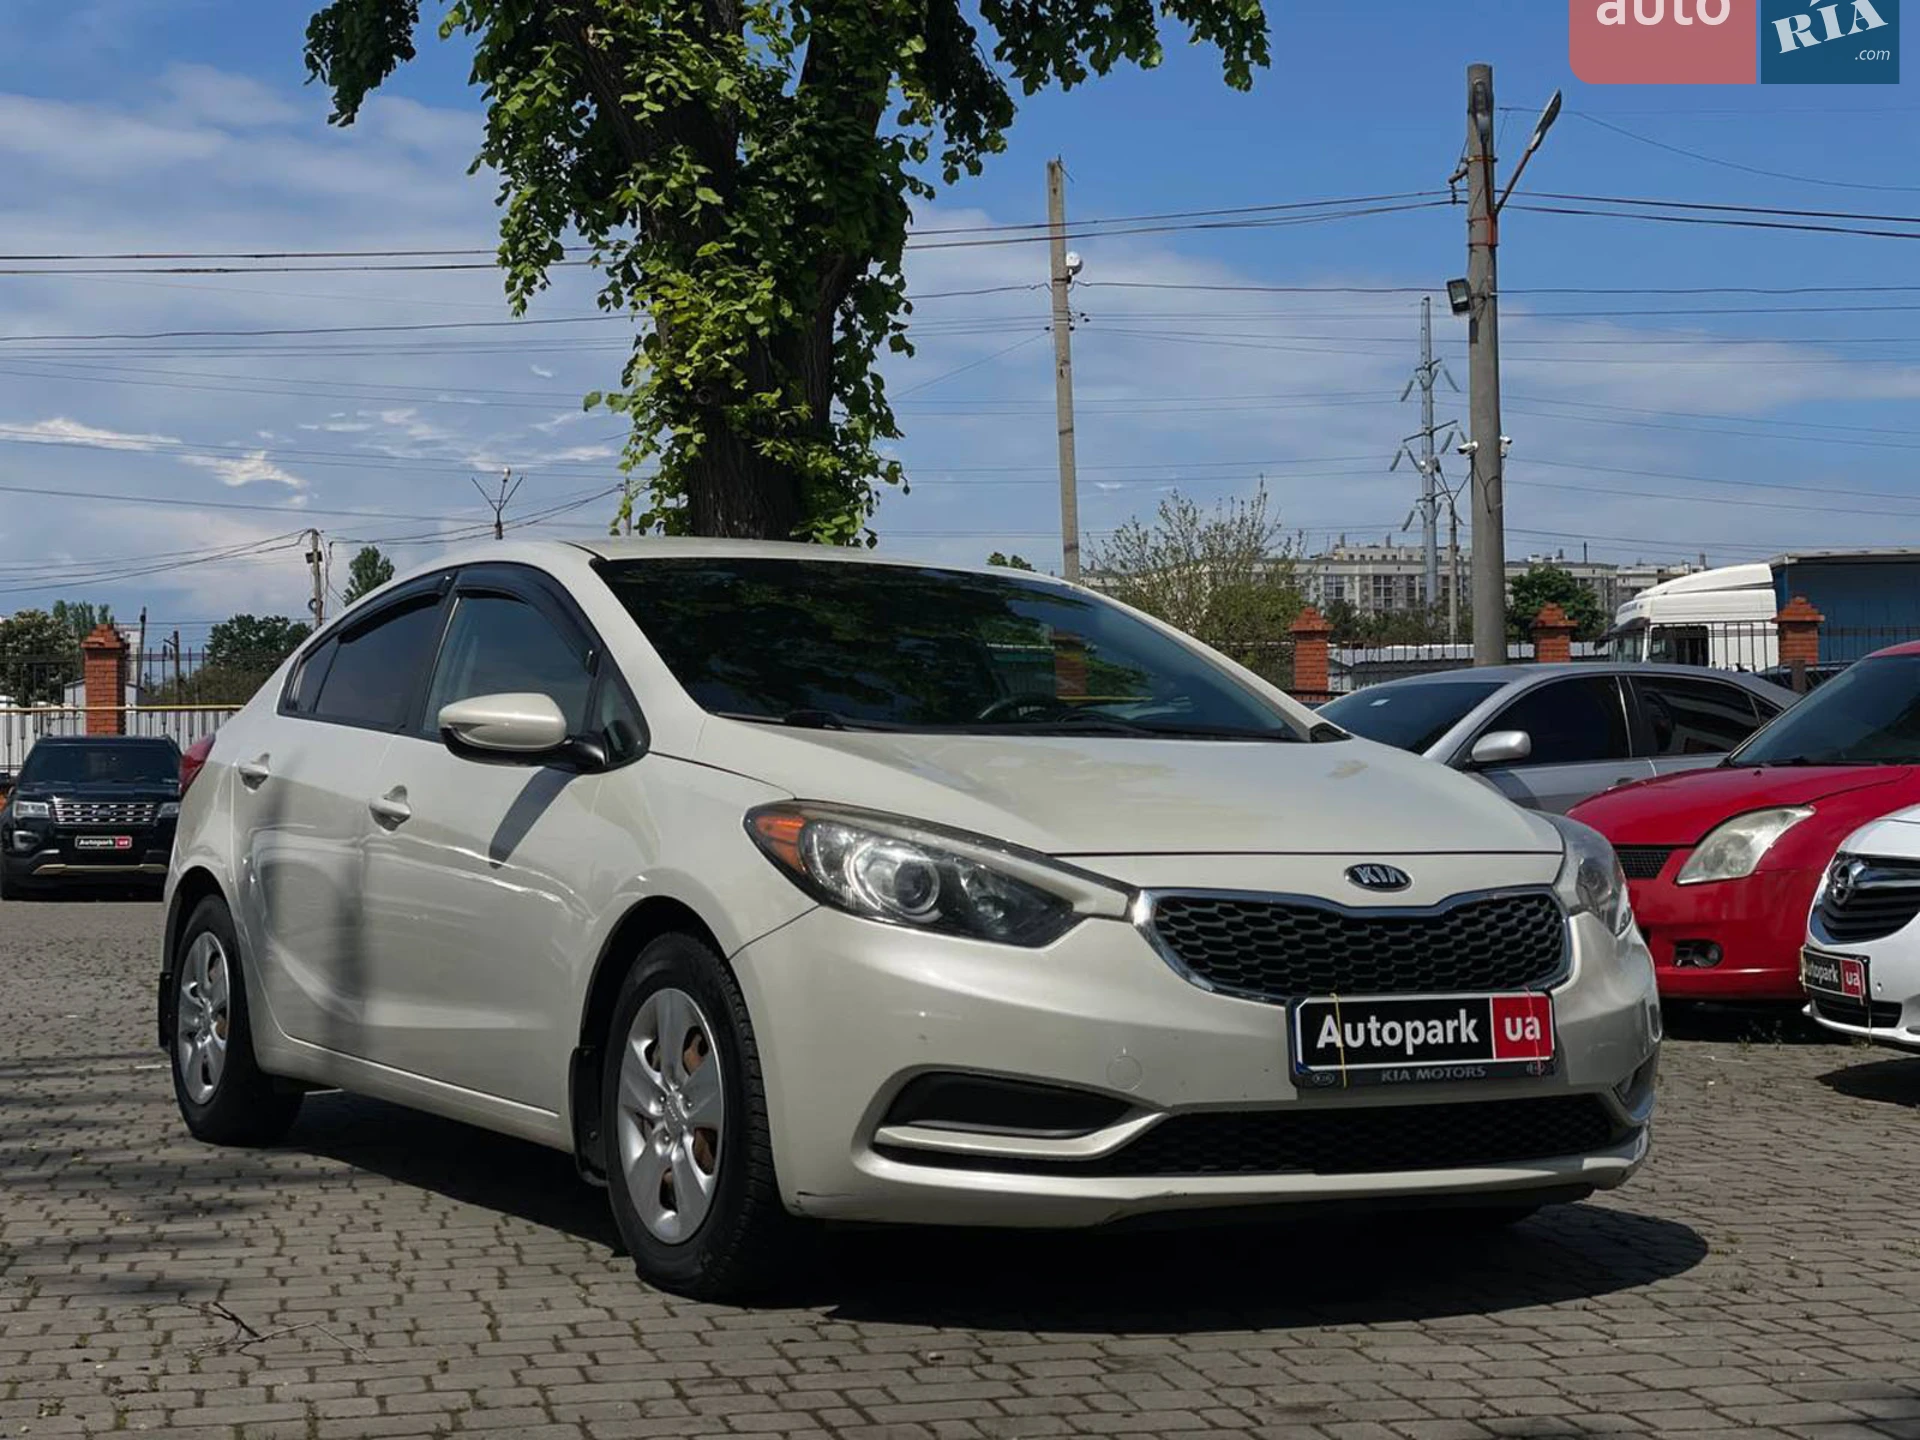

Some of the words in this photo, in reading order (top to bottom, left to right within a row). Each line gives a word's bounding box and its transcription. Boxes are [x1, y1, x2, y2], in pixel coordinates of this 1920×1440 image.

[1354, 866, 1406, 884] KIA
[1845, 971, 1860, 987] ua
[1316, 1009, 1479, 1055] Autopark
[1504, 1016, 1541, 1042] ua
[1381, 1070, 1411, 1081] KIA
[1416, 1066, 1487, 1080] MOTORS
